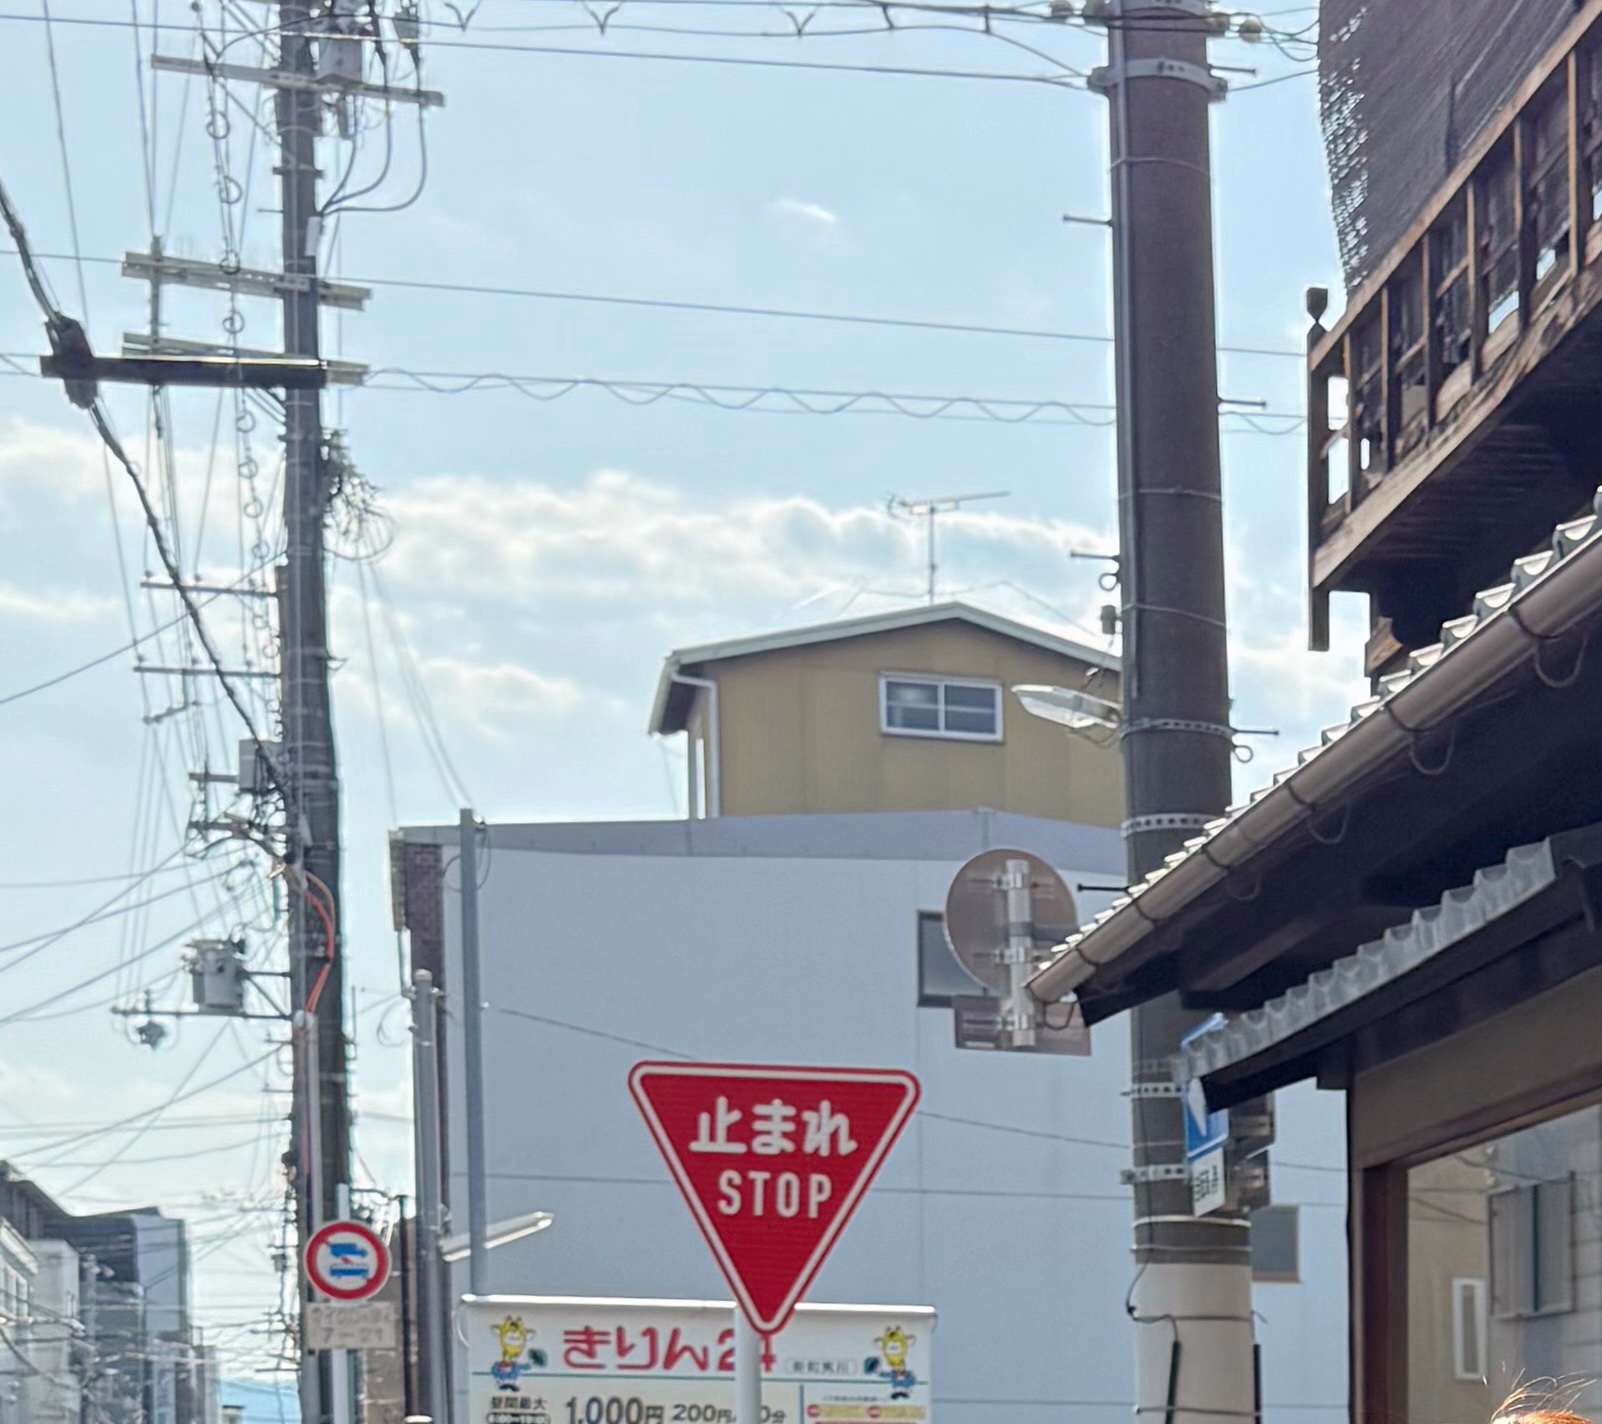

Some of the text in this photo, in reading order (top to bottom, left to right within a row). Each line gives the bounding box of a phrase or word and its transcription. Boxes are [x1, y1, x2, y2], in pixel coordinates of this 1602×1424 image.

[688, 1095, 858, 1157] 止まれ
[718, 1169, 832, 1219] STOP
